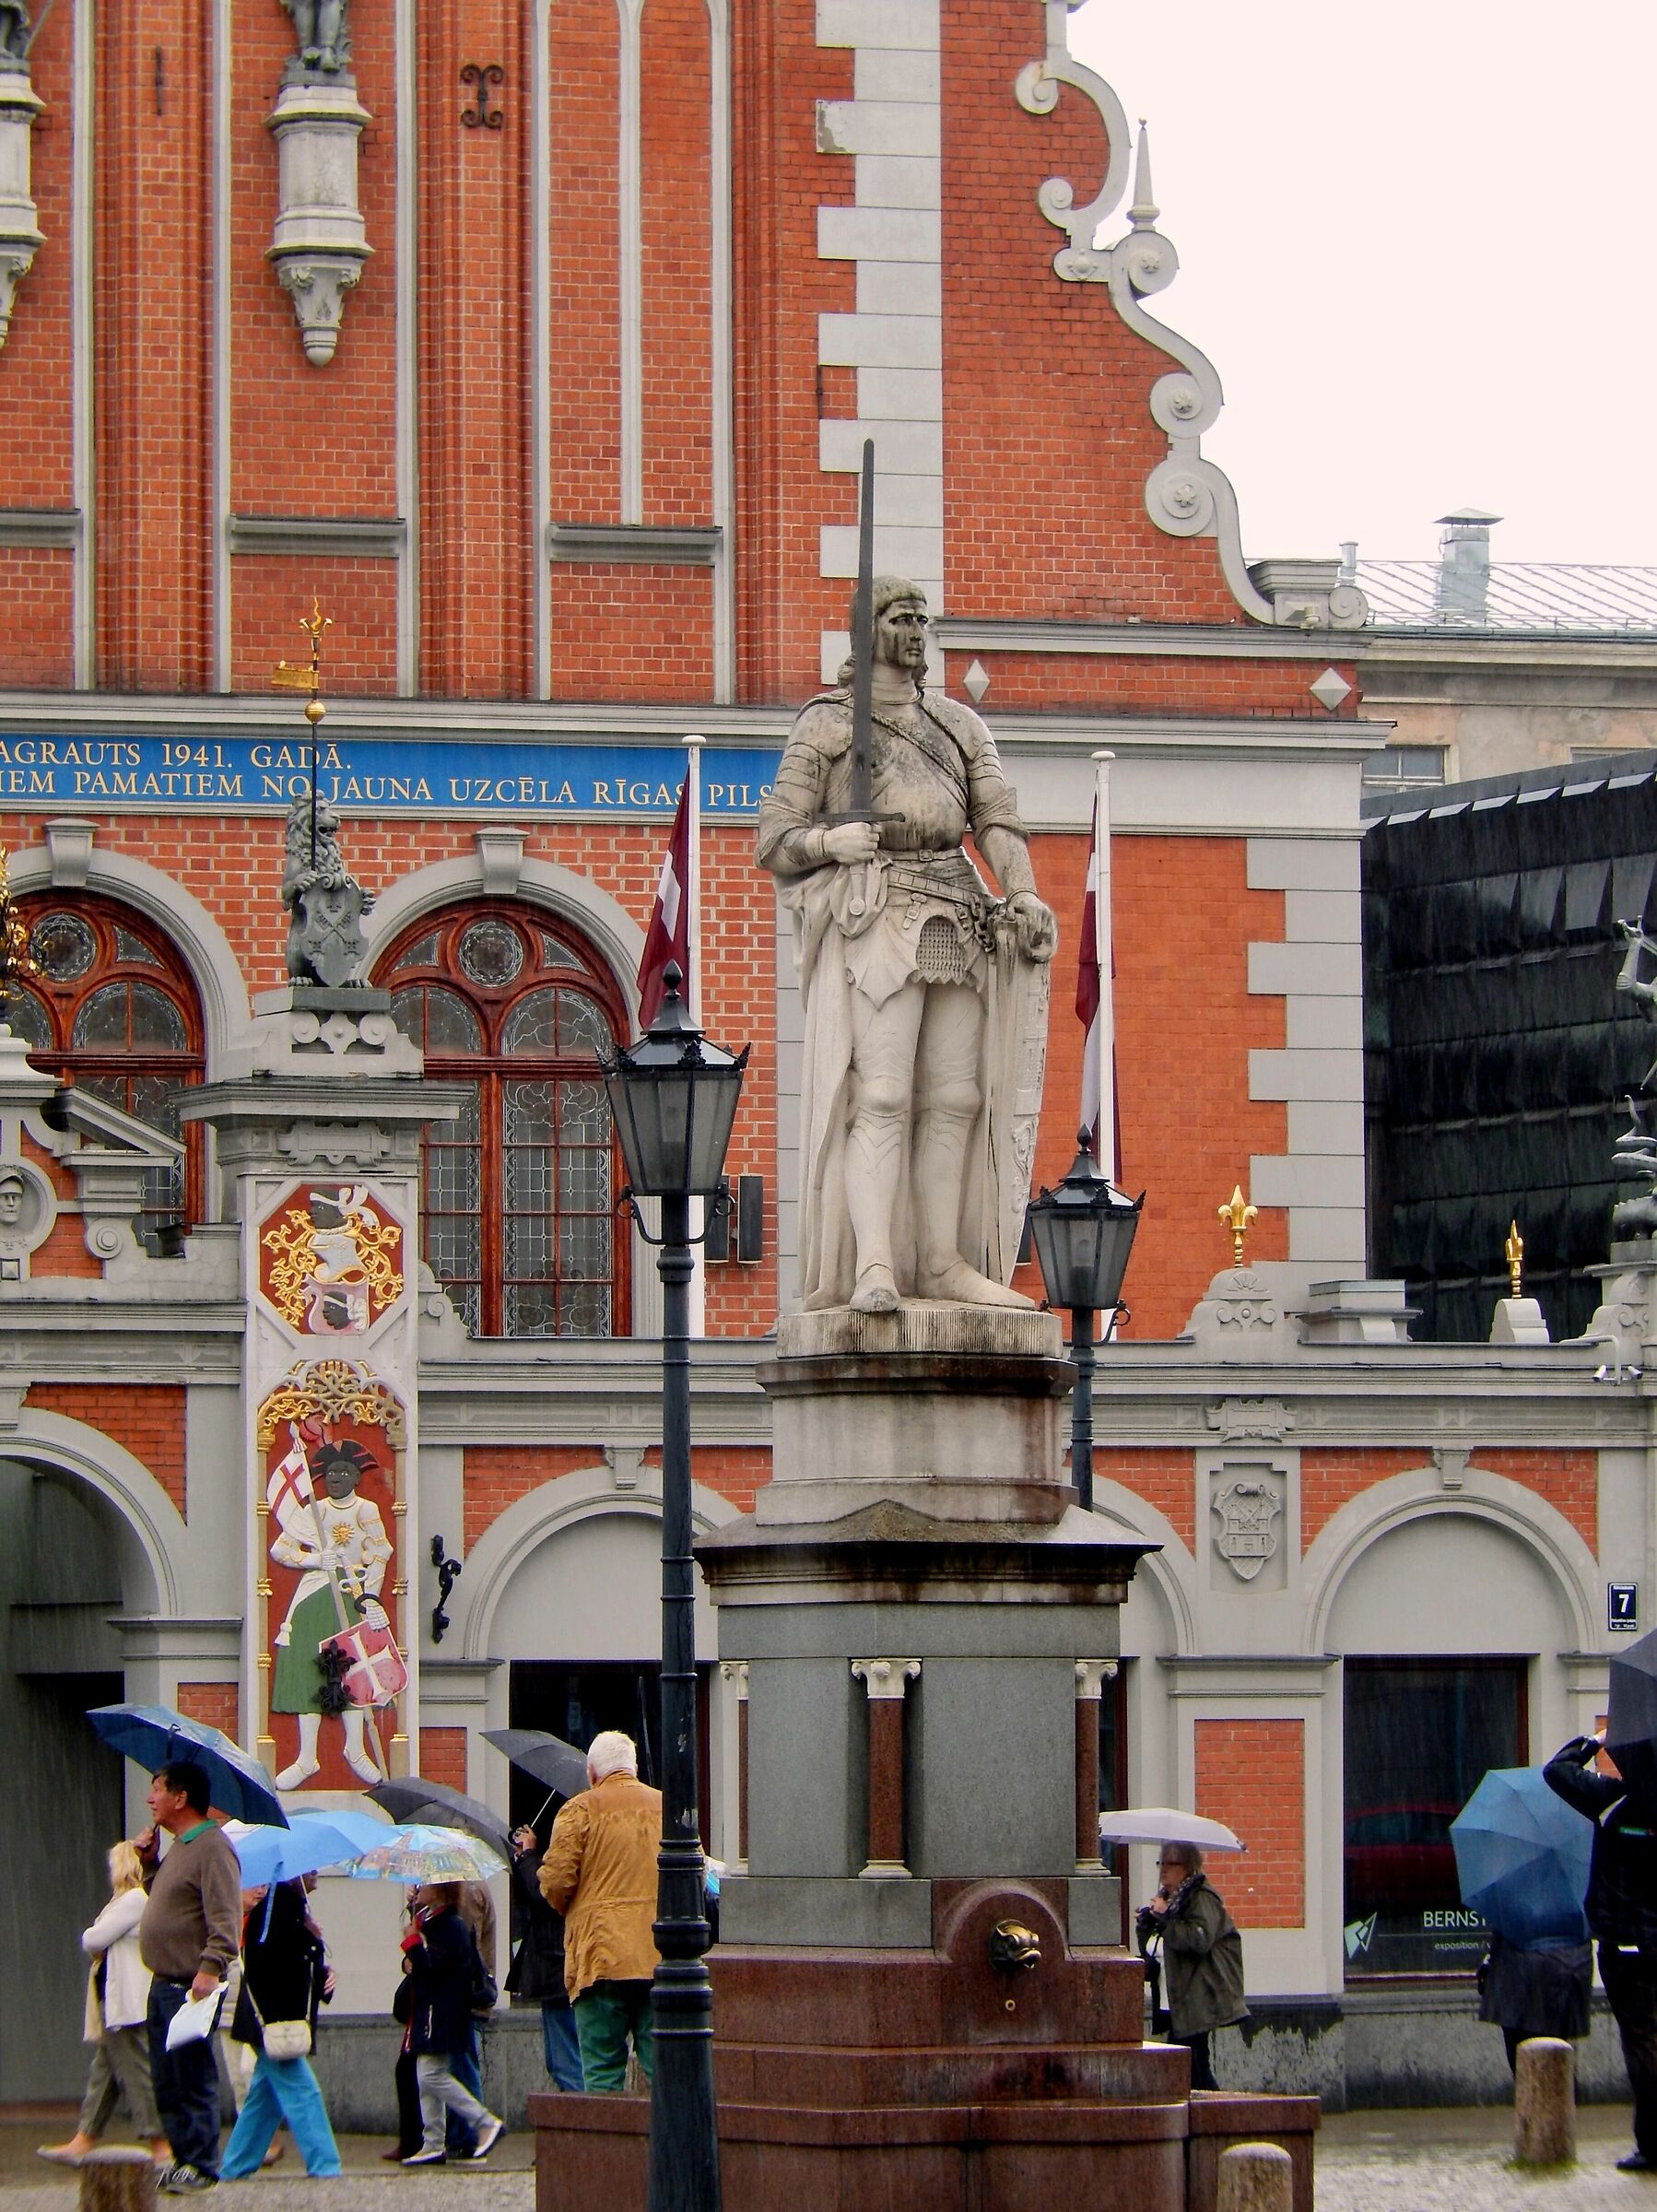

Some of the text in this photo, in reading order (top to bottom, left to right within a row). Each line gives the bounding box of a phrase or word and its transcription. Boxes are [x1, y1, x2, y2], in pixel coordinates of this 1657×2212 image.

[161, 743, 233, 768] 1941.
[251, 743, 352, 770] GADĀ.
[74, 771, 242, 798] PAMATIEM
[262, 775, 311, 797] NO
[329, 776, 434, 803] JAUNA
[449, 777, 577, 804] UZCĒLA
[1618, 1594, 1629, 1613] 7
[1434, 1940, 1479, 1951] exposition
